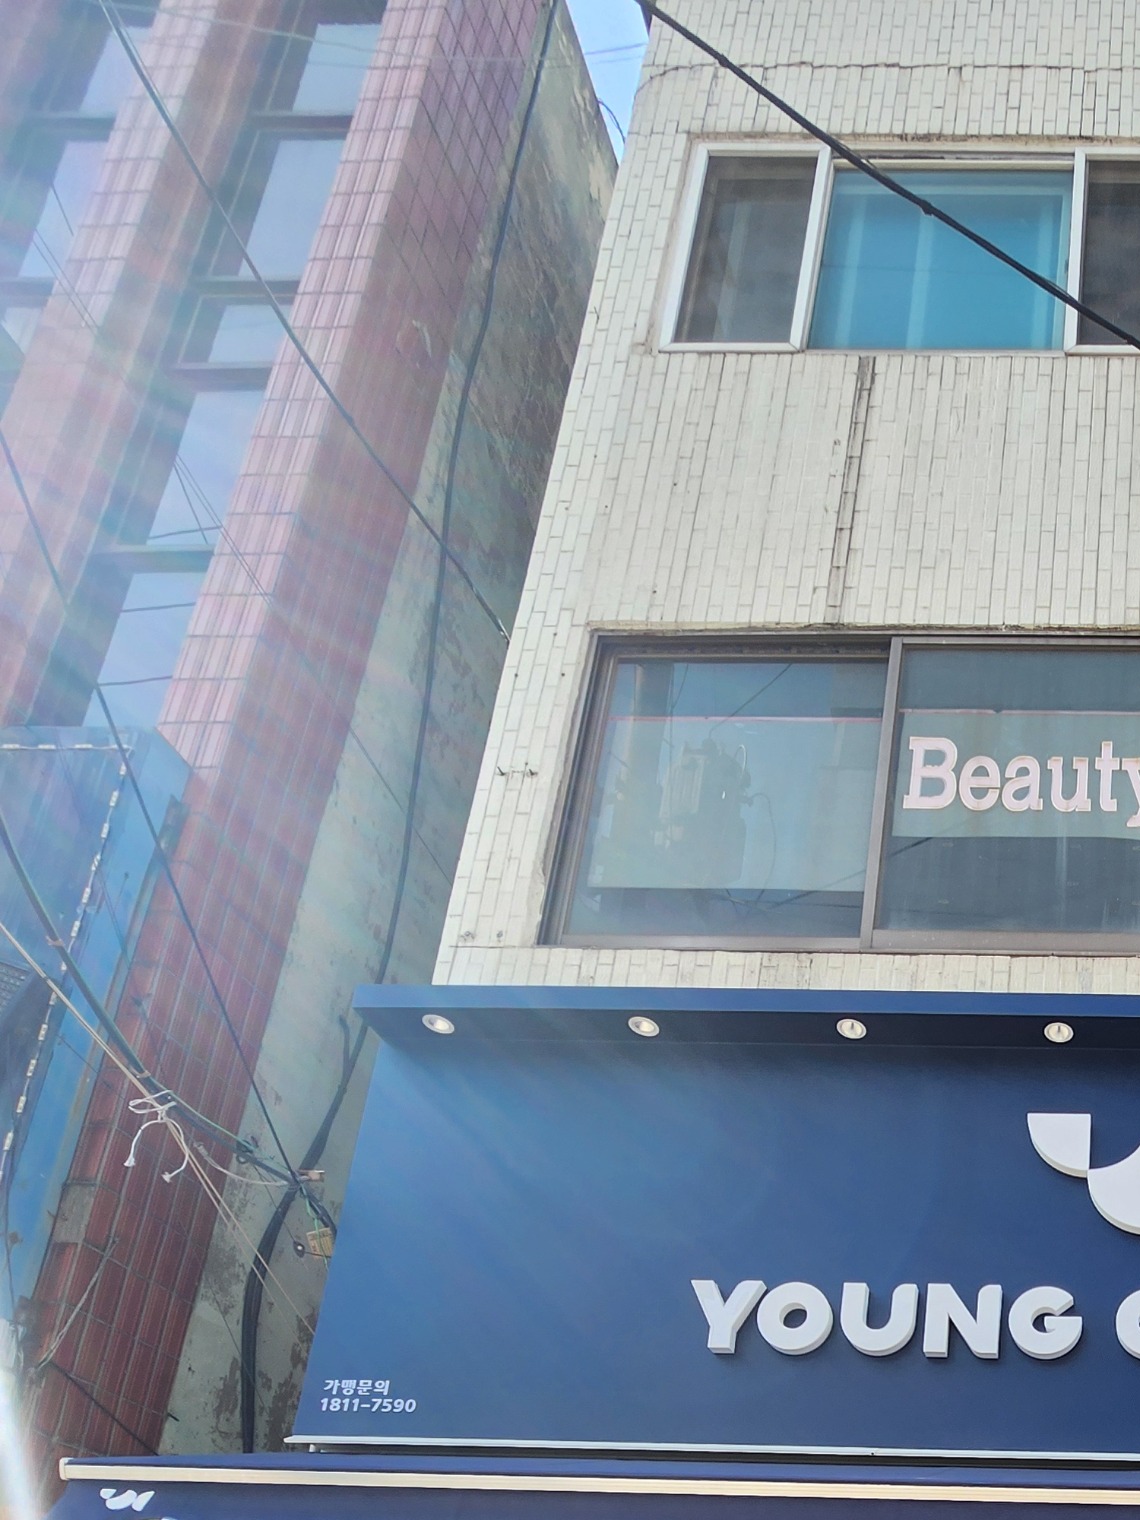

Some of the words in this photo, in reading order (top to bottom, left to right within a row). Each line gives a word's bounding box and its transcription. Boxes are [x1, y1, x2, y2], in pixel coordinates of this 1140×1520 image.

[692, 1279, 1082, 1360] YOUNG
[323, 1379, 390, 1396] 가맹문의
[320, 1398, 417, 1413] 1811-7590
